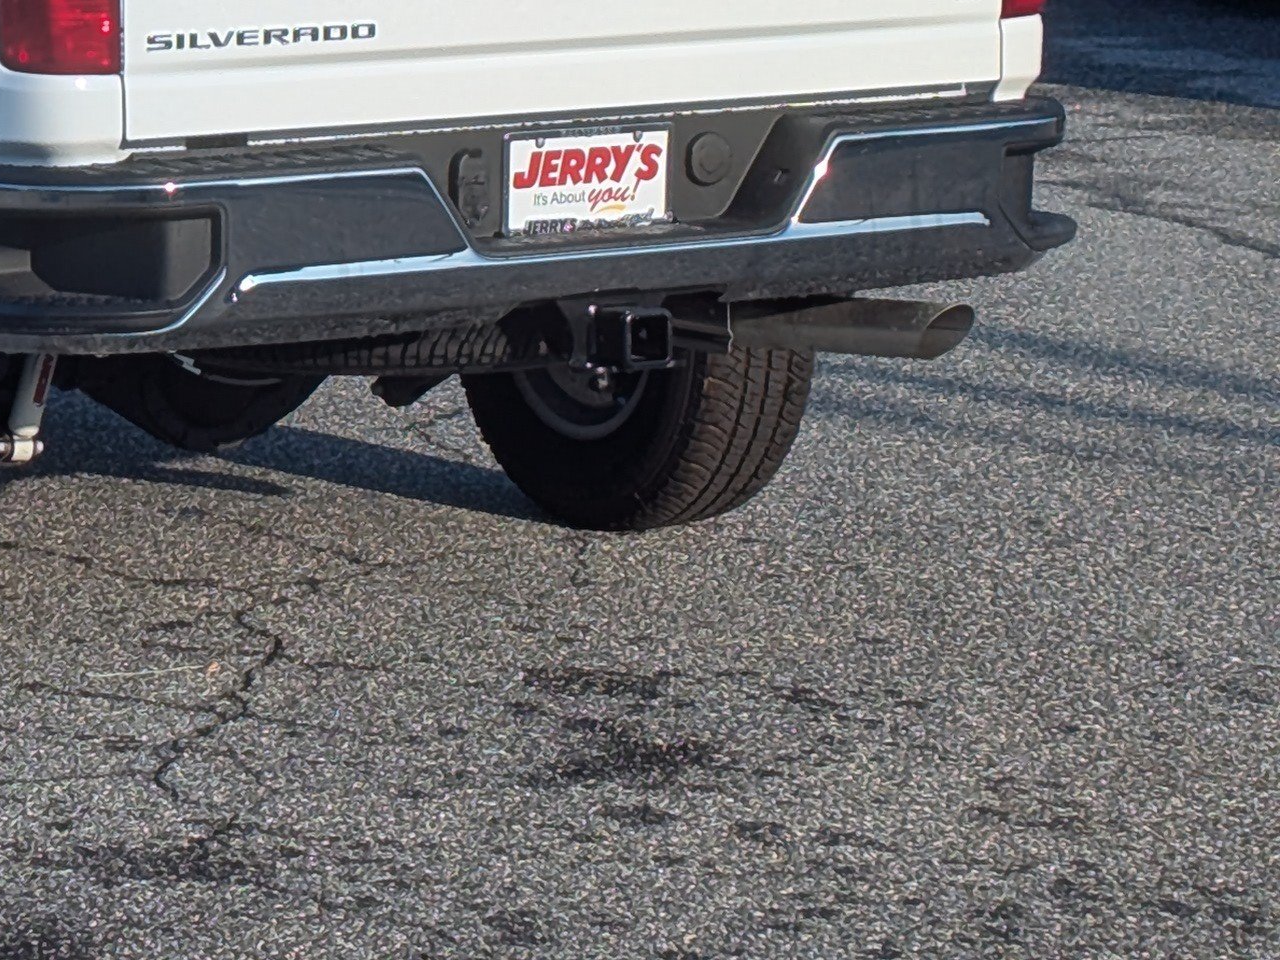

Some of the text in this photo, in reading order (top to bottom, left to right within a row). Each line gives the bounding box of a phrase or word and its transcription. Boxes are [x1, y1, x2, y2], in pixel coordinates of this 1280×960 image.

[146, 23, 376, 52] SILVERADO
[513, 143, 663, 189] JERRY'S
[533, 179, 640, 213] It's About you!
